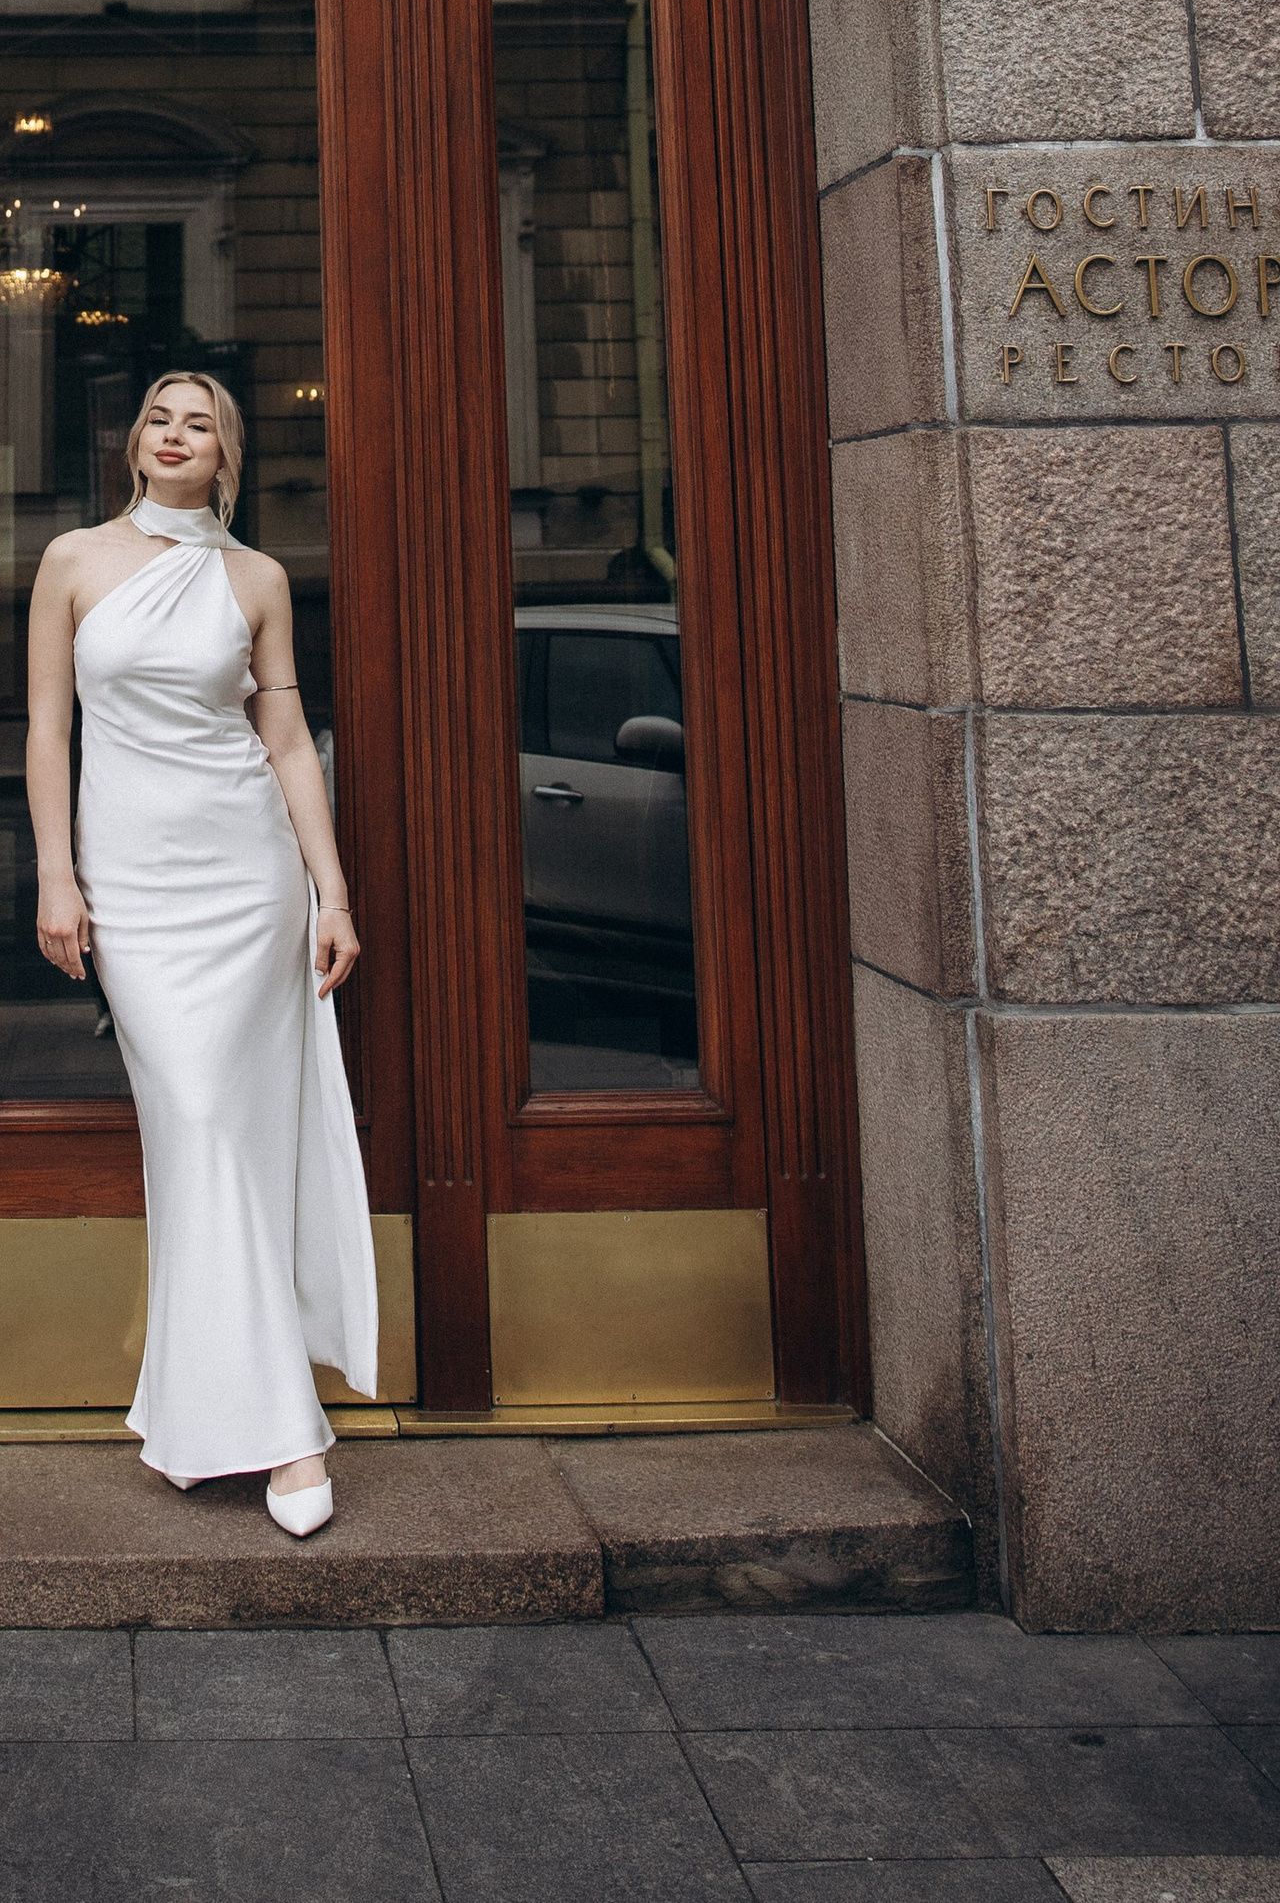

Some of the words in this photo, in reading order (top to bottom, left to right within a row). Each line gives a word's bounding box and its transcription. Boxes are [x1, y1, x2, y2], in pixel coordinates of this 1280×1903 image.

[985, 185, 1260, 230] ГОСТИН
[1009, 254, 1280, 317] АСТОР
[1001, 343, 1245, 384] РЕСТО
